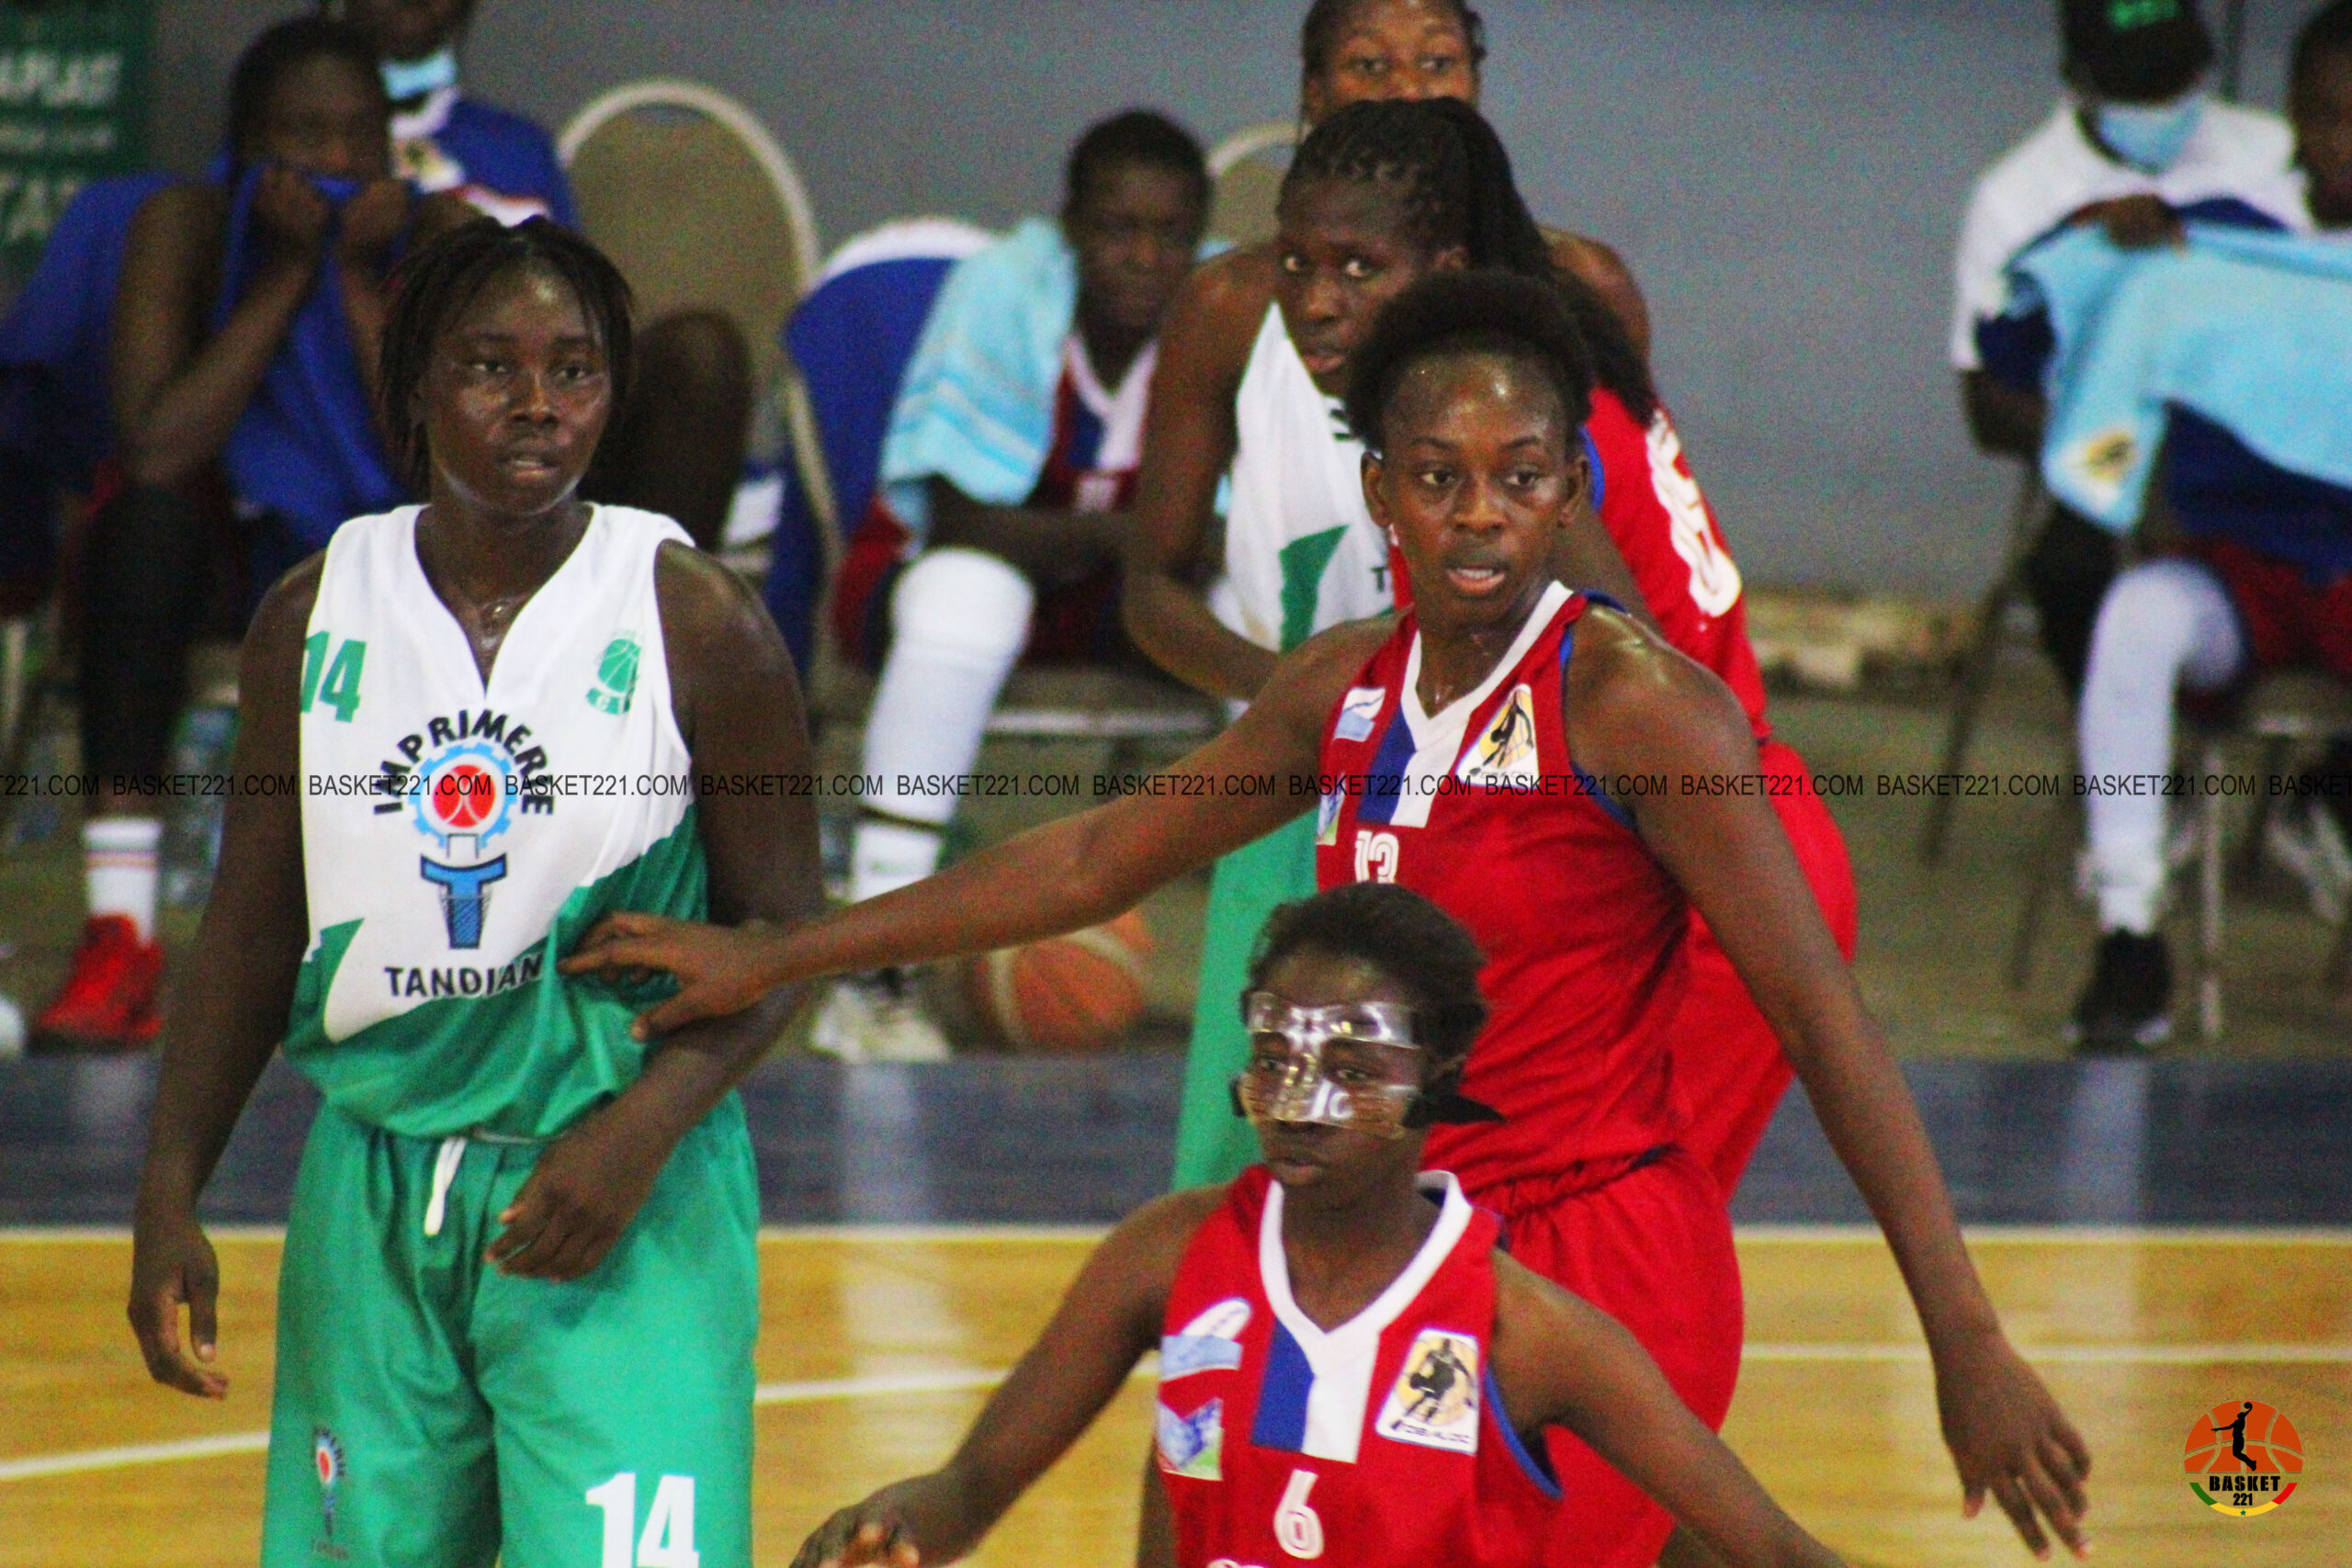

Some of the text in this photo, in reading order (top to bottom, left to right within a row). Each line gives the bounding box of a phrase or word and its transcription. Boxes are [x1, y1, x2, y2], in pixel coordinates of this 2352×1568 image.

[300, 630, 368, 723] 14
[384, 953, 543, 997] TANDIAN
[585, 1472, 699, 1568] 14
[1273, 1469, 1324, 1560] 6
